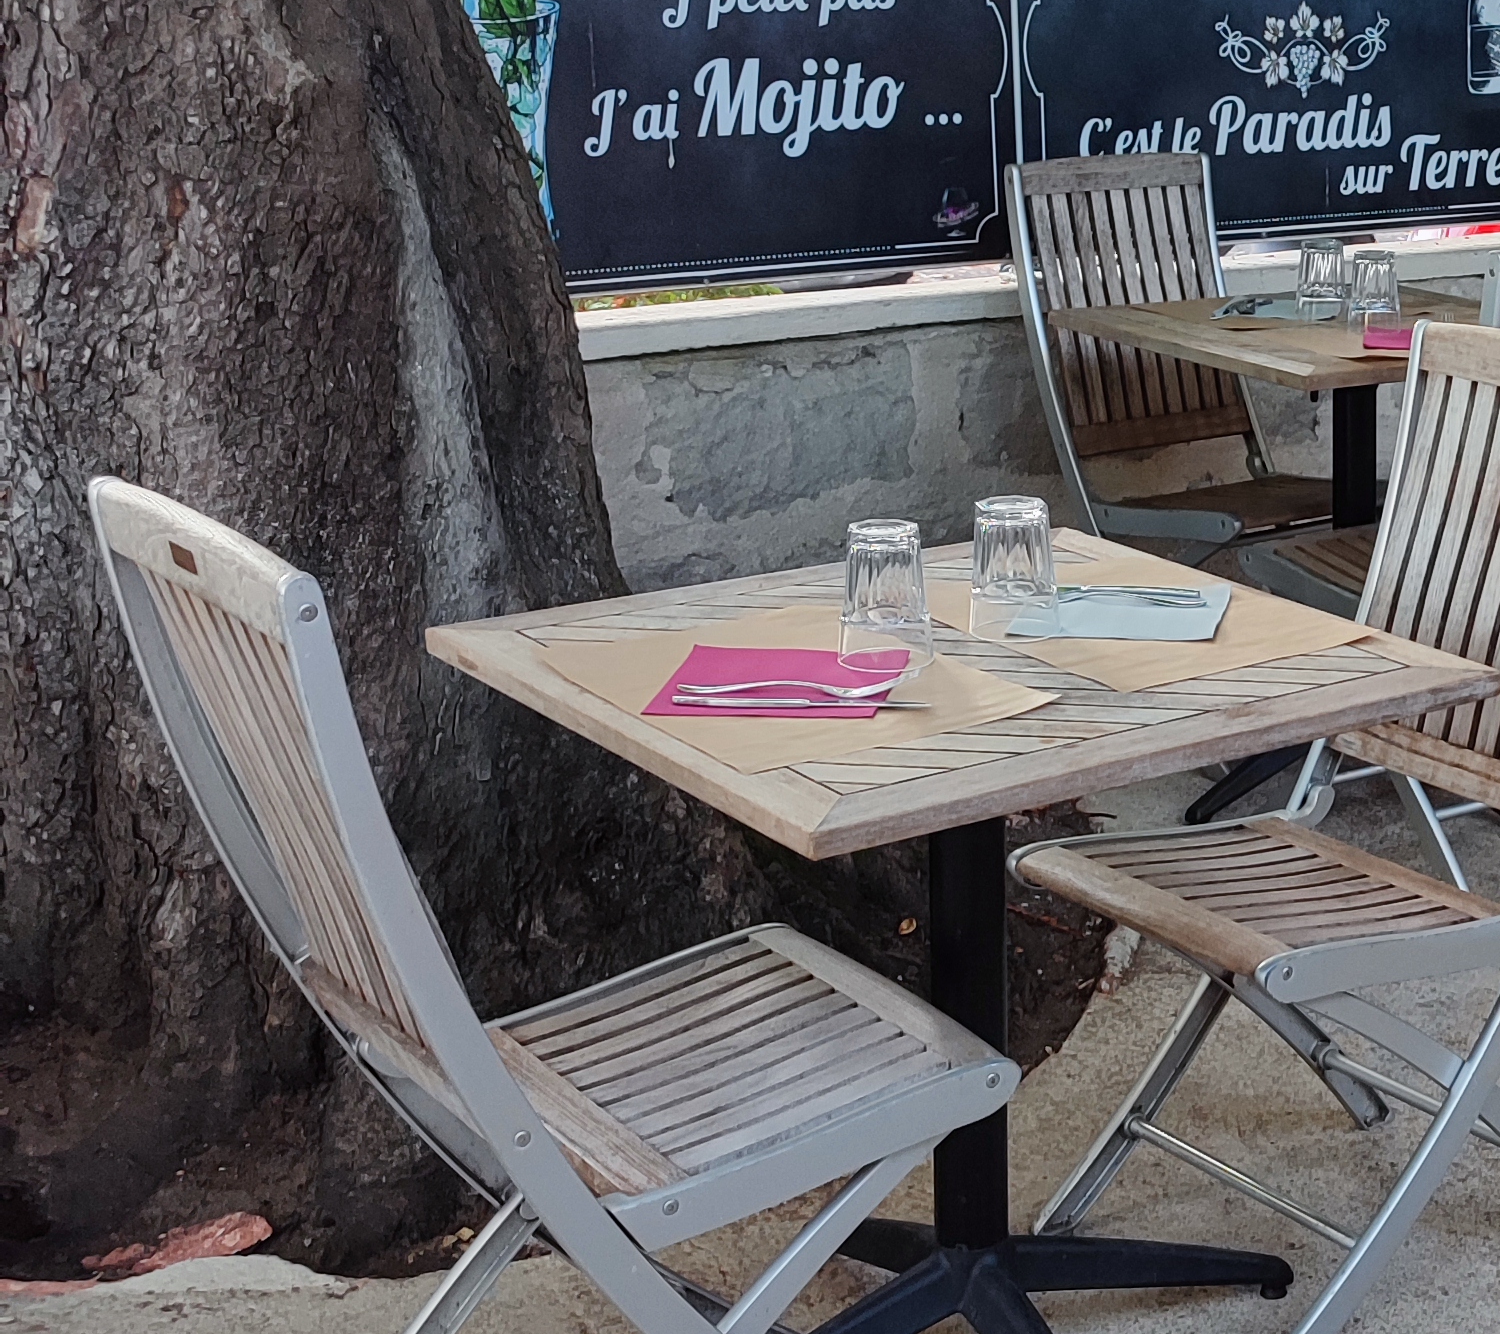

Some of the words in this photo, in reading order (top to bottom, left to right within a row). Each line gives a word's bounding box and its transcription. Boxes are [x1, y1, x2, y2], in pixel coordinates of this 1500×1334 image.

[583, 87, 680, 157] J'ai
[693, 57, 905, 158] Mojito
[1171, 117, 1202, 154] le
[1208, 92, 1392, 156] Paradis
[1339, 164, 1394, 196] sur
